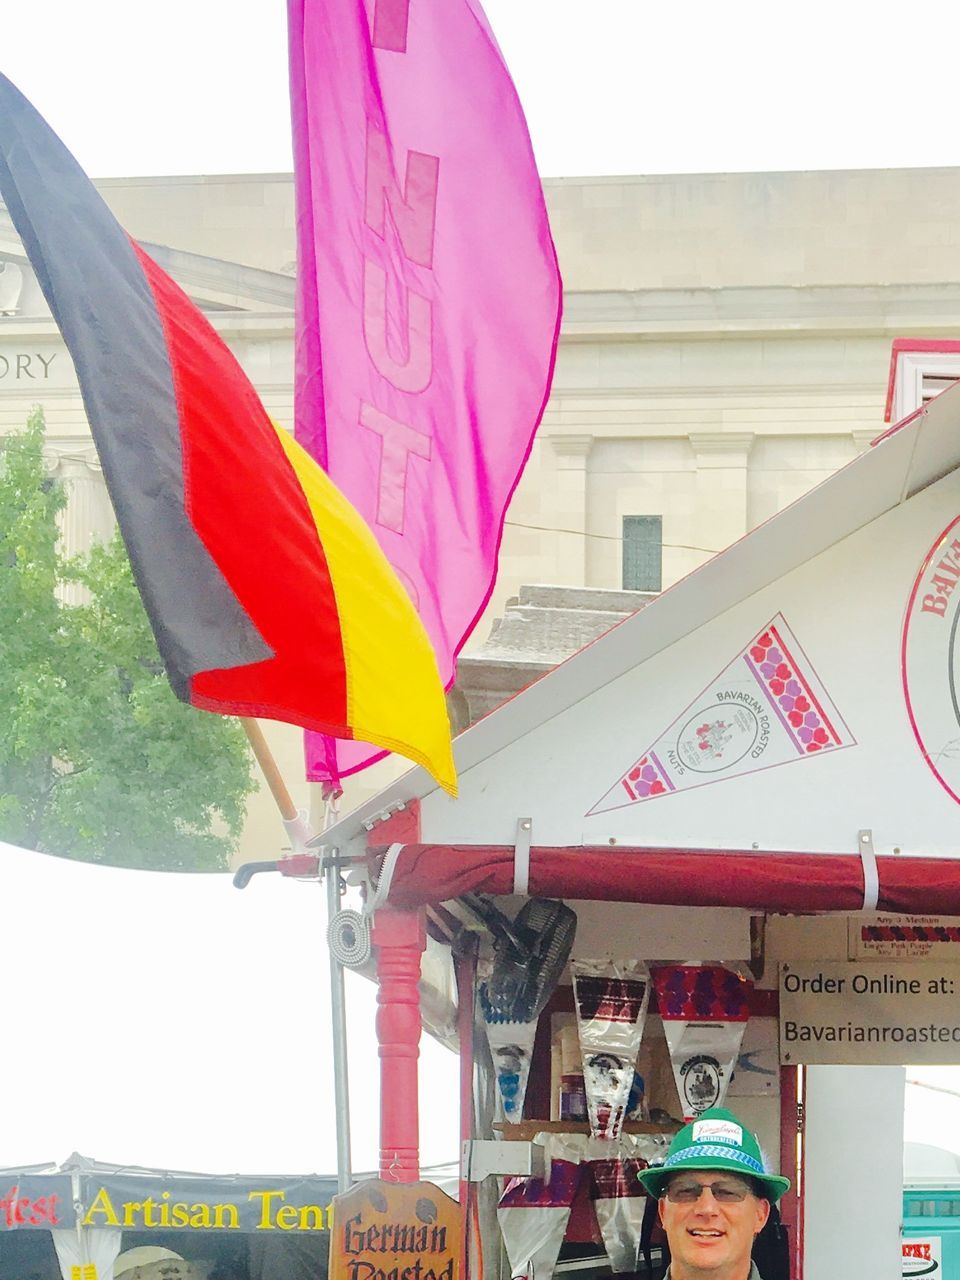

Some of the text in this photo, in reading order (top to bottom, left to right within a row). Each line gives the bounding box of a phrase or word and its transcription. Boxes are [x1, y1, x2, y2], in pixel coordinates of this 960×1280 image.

[360, 110, 440, 612] NUT
[716, 690, 764, 715] BAVARIAN
[750, 714, 770, 759] ROASTED
[667, 750, 686, 776] NUTS
[784, 973, 954, 994] Order Online at:
[80, 1187, 334, 1231] Artisan Tent
[344, 1212, 448, 1255] German
